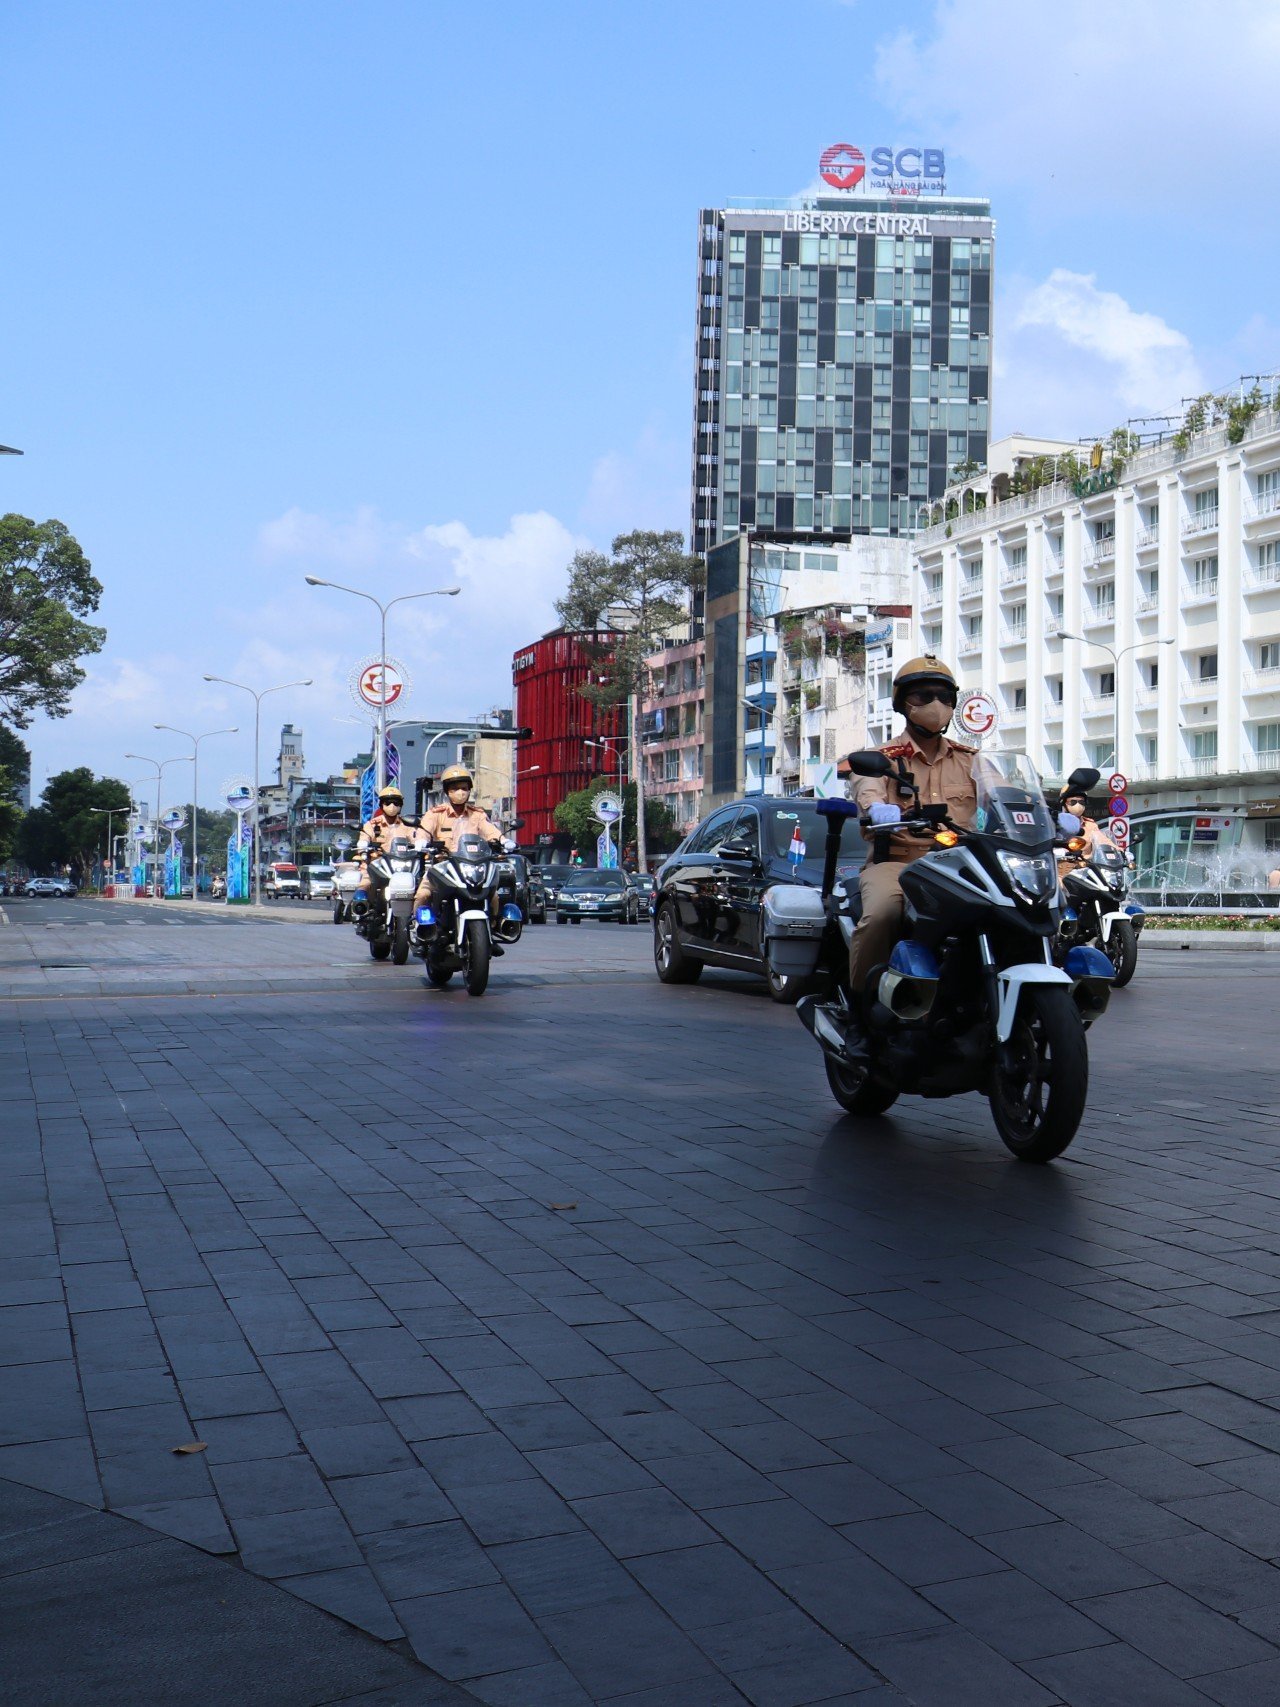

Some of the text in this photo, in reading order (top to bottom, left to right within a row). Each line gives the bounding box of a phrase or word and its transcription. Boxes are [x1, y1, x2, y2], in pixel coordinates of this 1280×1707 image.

[871, 146, 946, 178] SCB
[784, 214, 932, 236] LIBERTY CENTRAL
[1016, 813, 1032, 824] 01
